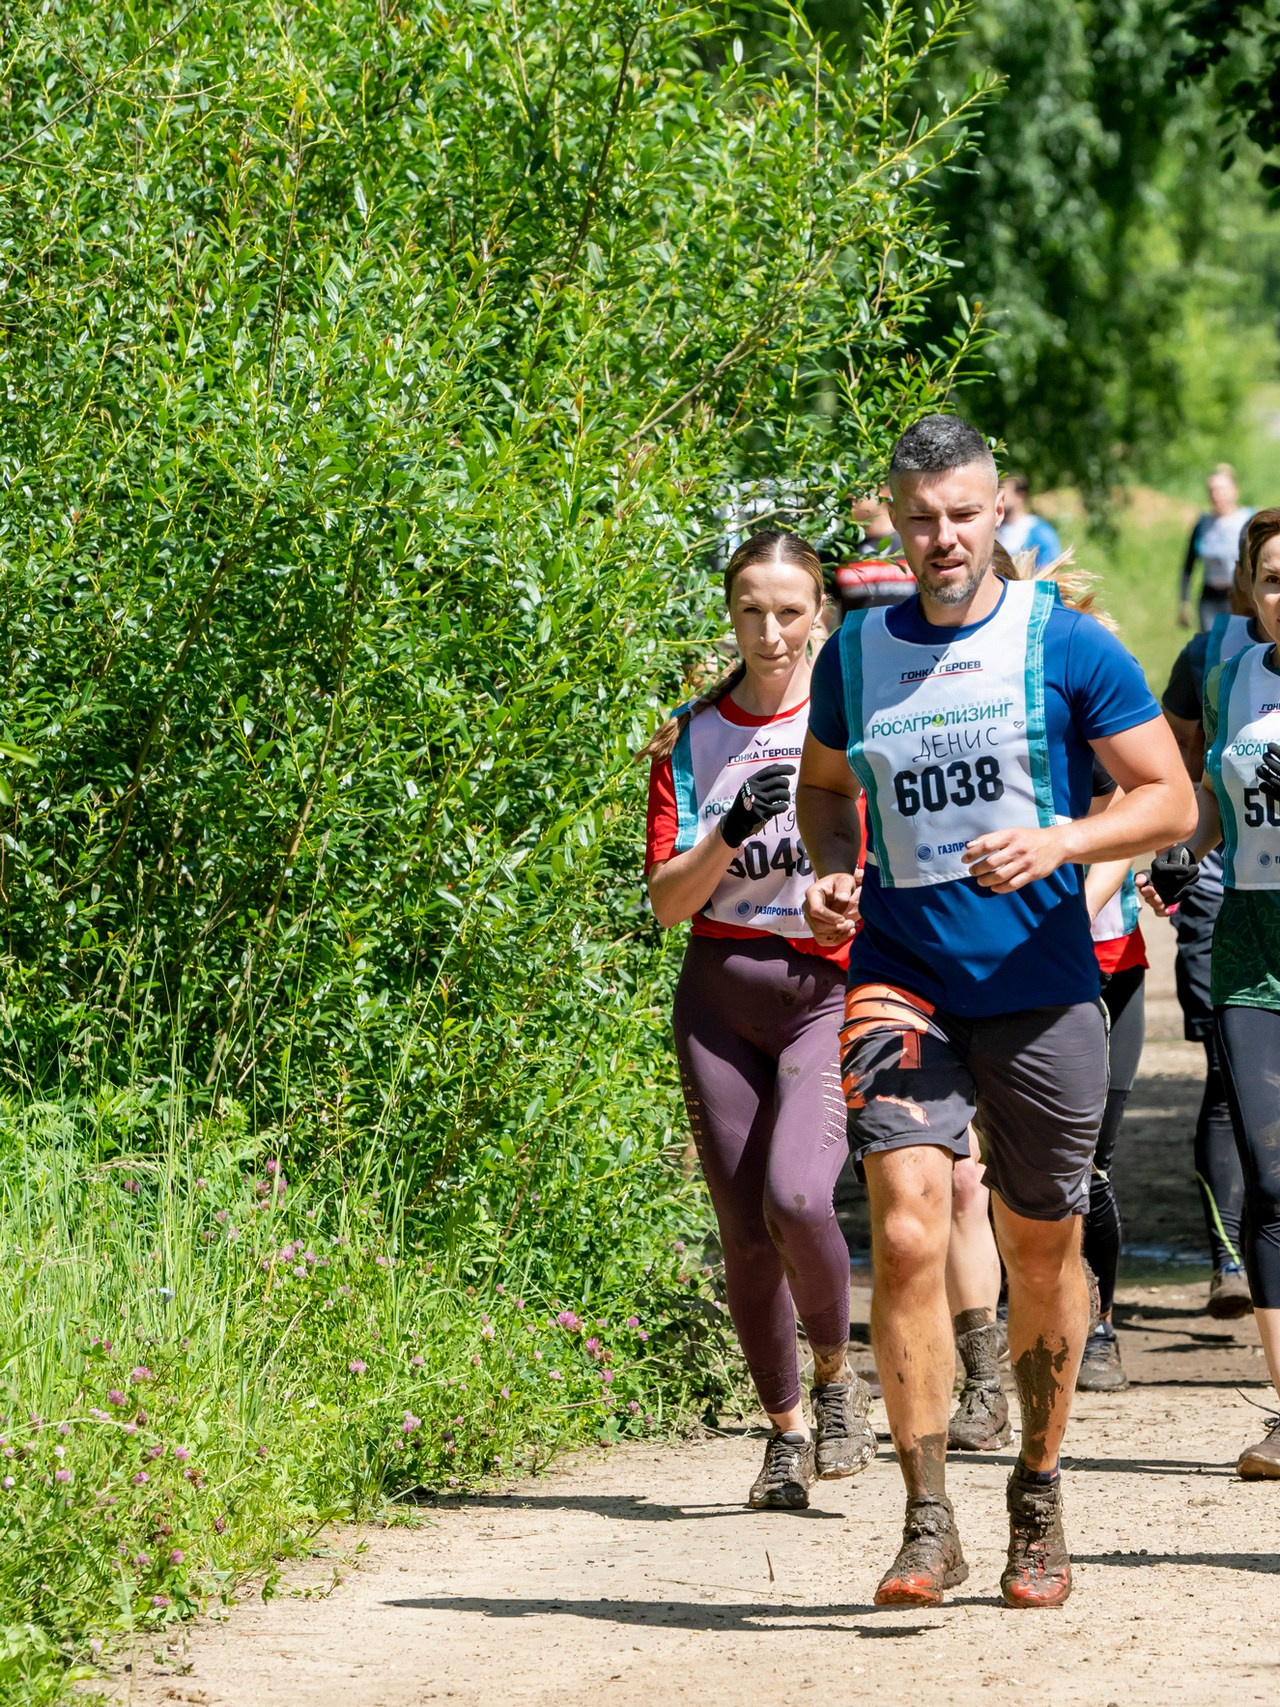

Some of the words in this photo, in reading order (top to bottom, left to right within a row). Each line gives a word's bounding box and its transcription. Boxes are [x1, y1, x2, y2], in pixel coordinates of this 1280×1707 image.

[901, 667, 936, 681] ГОНКА
[939, 660, 982, 674] ГЕРОЕВ
[875, 706, 947, 724] АКЦИОНЕРНОЕ
[954, 696, 1010, 711] ОБЩЕСТВО
[728, 751, 760, 764] ГОНКА
[762, 747, 802, 758] ГЕРОЕВ
[912, 726, 999, 763] ДЕНИС
[893, 755, 1005, 817] 6038
